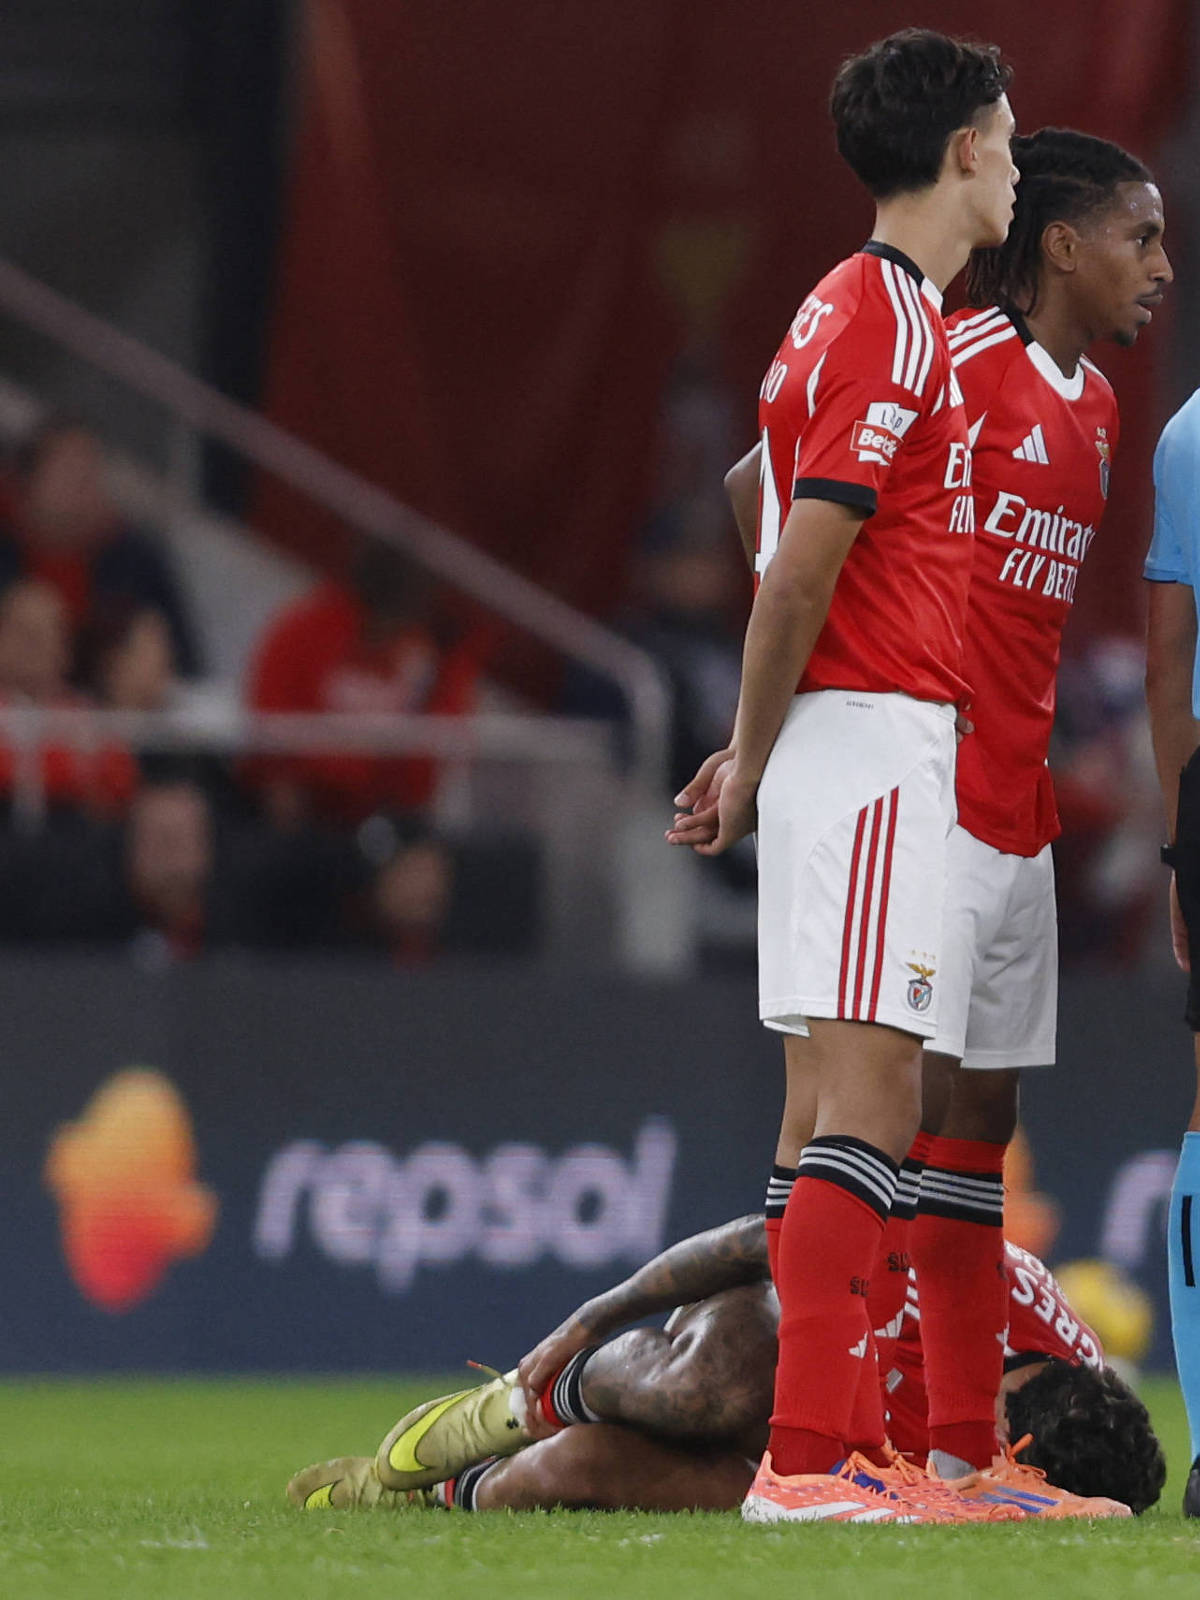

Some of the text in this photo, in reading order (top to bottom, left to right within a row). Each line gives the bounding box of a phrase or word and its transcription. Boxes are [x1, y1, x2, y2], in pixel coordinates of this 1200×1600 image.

[984, 491, 1096, 563] Emirat
[999, 548, 1047, 591] FLY
[252, 1114, 678, 1294] repsol
[1011, 1266, 1103, 1373] GRES
